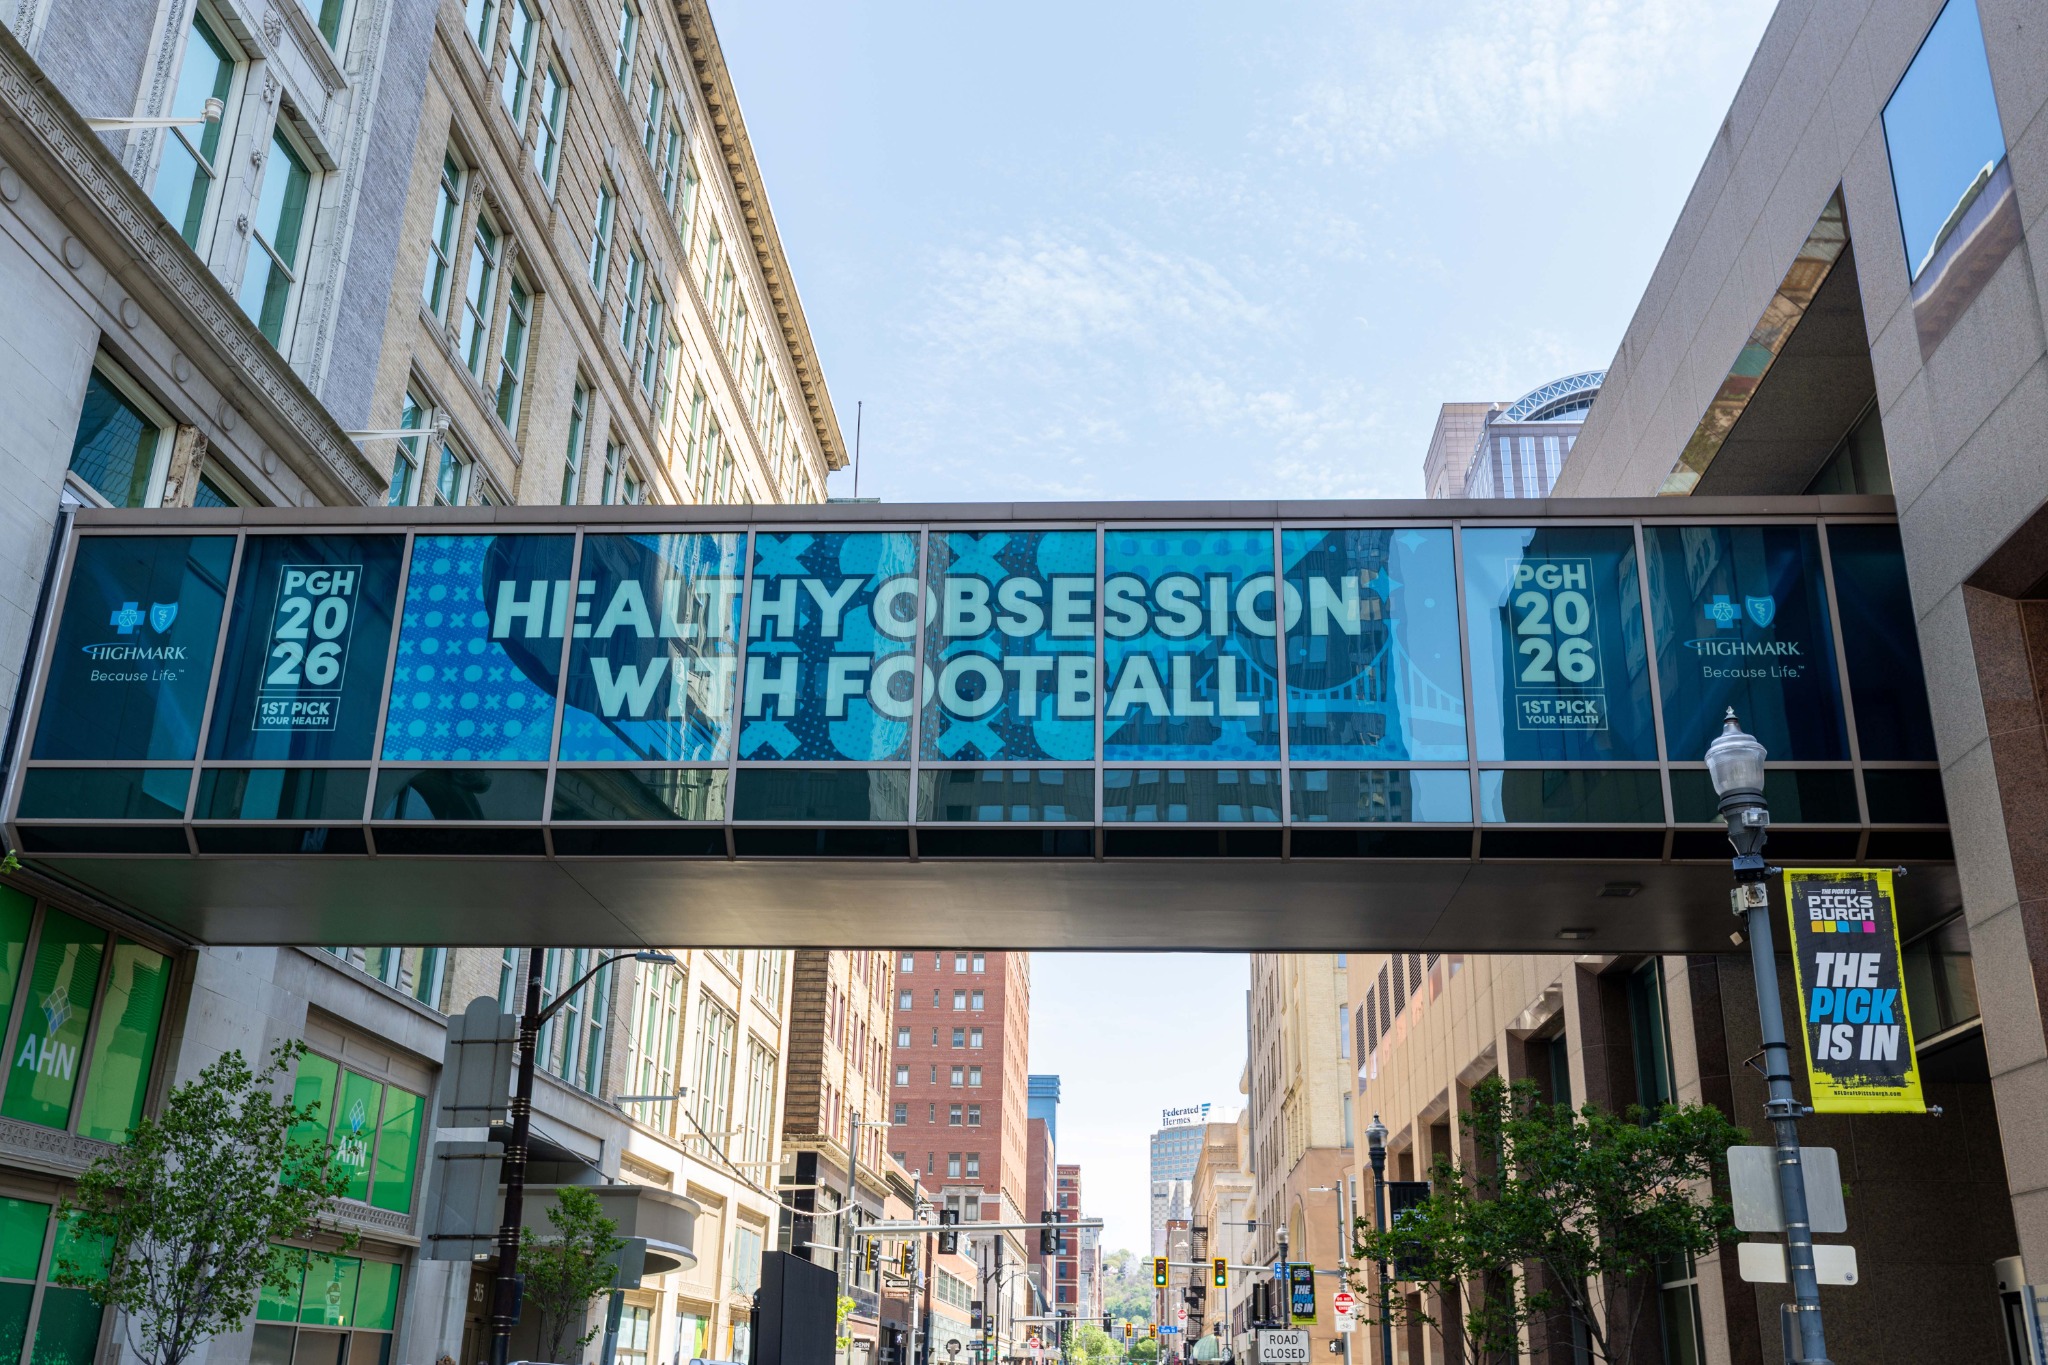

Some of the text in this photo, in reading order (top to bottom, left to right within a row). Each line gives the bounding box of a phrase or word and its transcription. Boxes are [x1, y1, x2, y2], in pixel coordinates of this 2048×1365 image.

[284, 570, 356, 595] PGH
[1514, 563, 1587, 589] PGH
[493, 576, 1362, 638] HEALTHY OBSESSION
[1515, 591, 1590, 635] 20
[275, 596, 349, 640] 20
[90, 646, 187, 660] HIGHMARK
[1696, 640, 1801, 656] HIGHMARK
[266, 641, 343, 686] 26
[1518, 637, 1596, 683] 26
[90, 670, 149, 682] Because
[1703, 665, 1767, 678] Because
[590, 655, 1260, 718] WITH FOOTBALL
[261, 702, 330, 715] 1ST PICK
[1522, 700, 1598, 714] 1ST PICK
[261, 716, 329, 725] YOUR HEALTH
[1525, 715, 1599, 724] YOUR HEALTH
[1807, 895, 1873, 908] PICKS
[1809, 908, 1875, 920] BURGH
[1815, 952, 1881, 988] THE
[1809, 987, 1898, 1024] PICK
[1817, 1024, 1900, 1061] IS IN
[17, 1033, 76, 1081] AHN
[1162, 1105, 1199, 1117] Federated
[1163, 1116, 1191, 1126] Hermes
[336, 1135, 368, 1168] AHN
[473, 1282, 485, 1302] 515
[1294, 1285, 1311, 1294] THE
[1293, 1294, 1314, 1303] PICK
[1293, 1303, 1314, 1312] IS IN
[1269, 1334, 1299, 1345] ROAD
[1263, 1348, 1306, 1359] CLOSED
